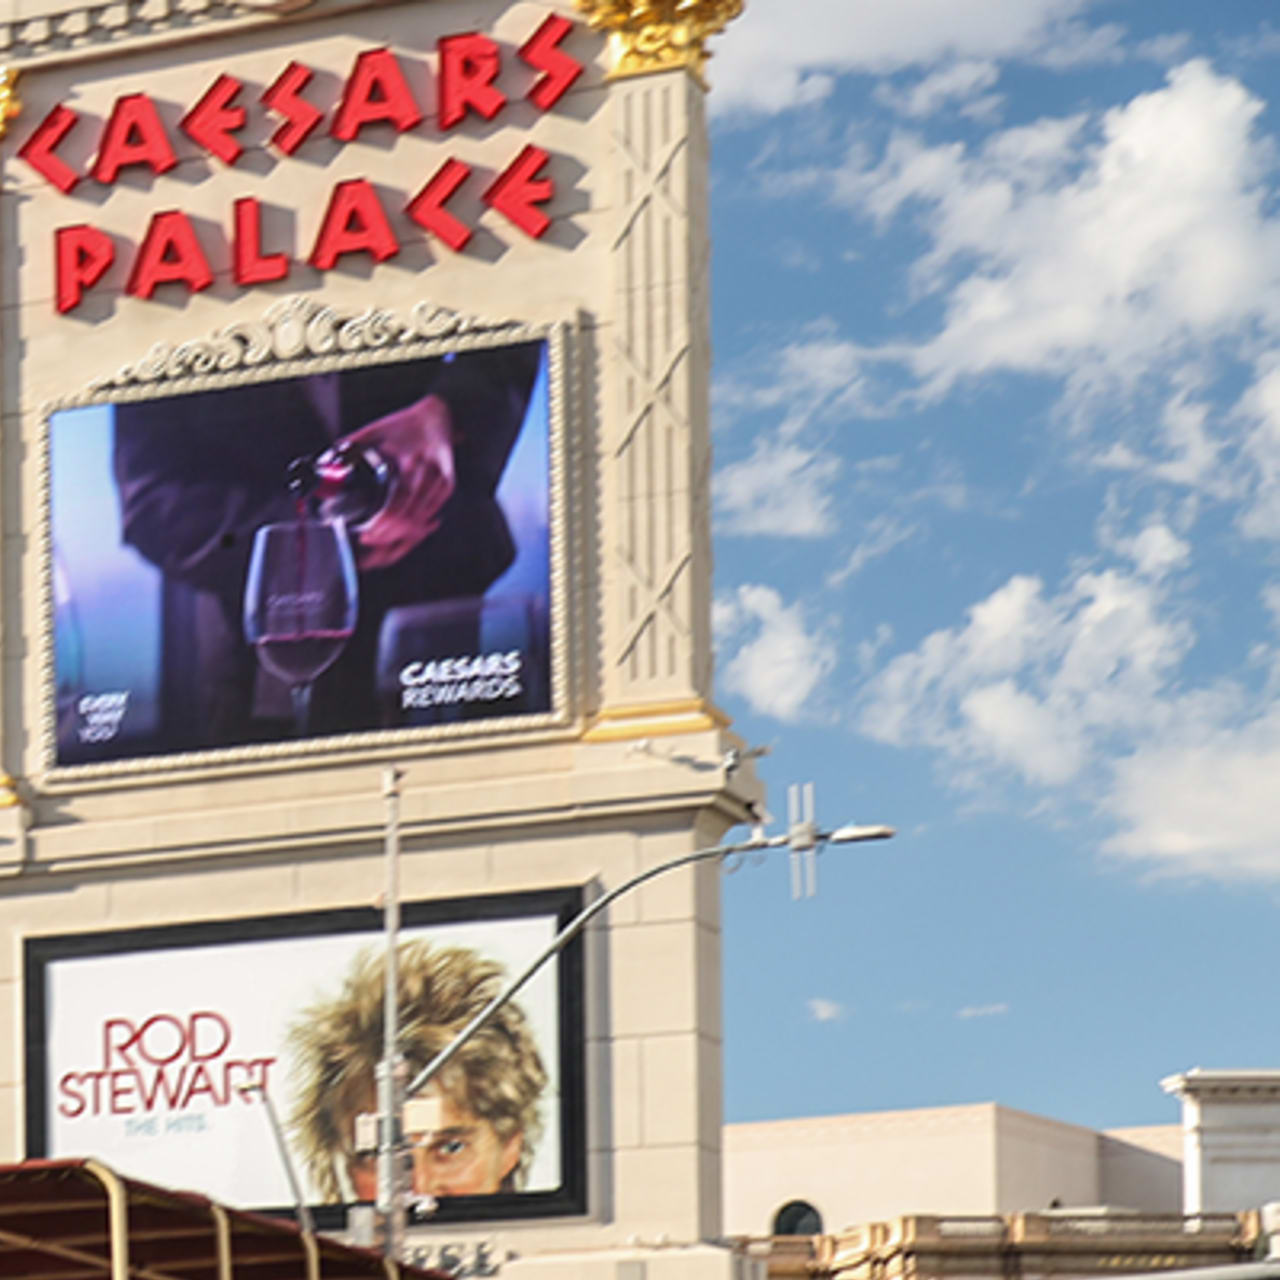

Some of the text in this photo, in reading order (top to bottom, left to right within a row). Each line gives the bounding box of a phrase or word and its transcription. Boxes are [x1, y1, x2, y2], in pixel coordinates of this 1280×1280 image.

[17, 12, 584, 194] CAESARS
[54, 143, 555, 315] PALACE
[399, 650, 522, 686] CAESARS
[401, 675, 523, 709] REWARDS
[103, 1010, 232, 1070] ROD
[57, 1057, 278, 1118] STEWART
